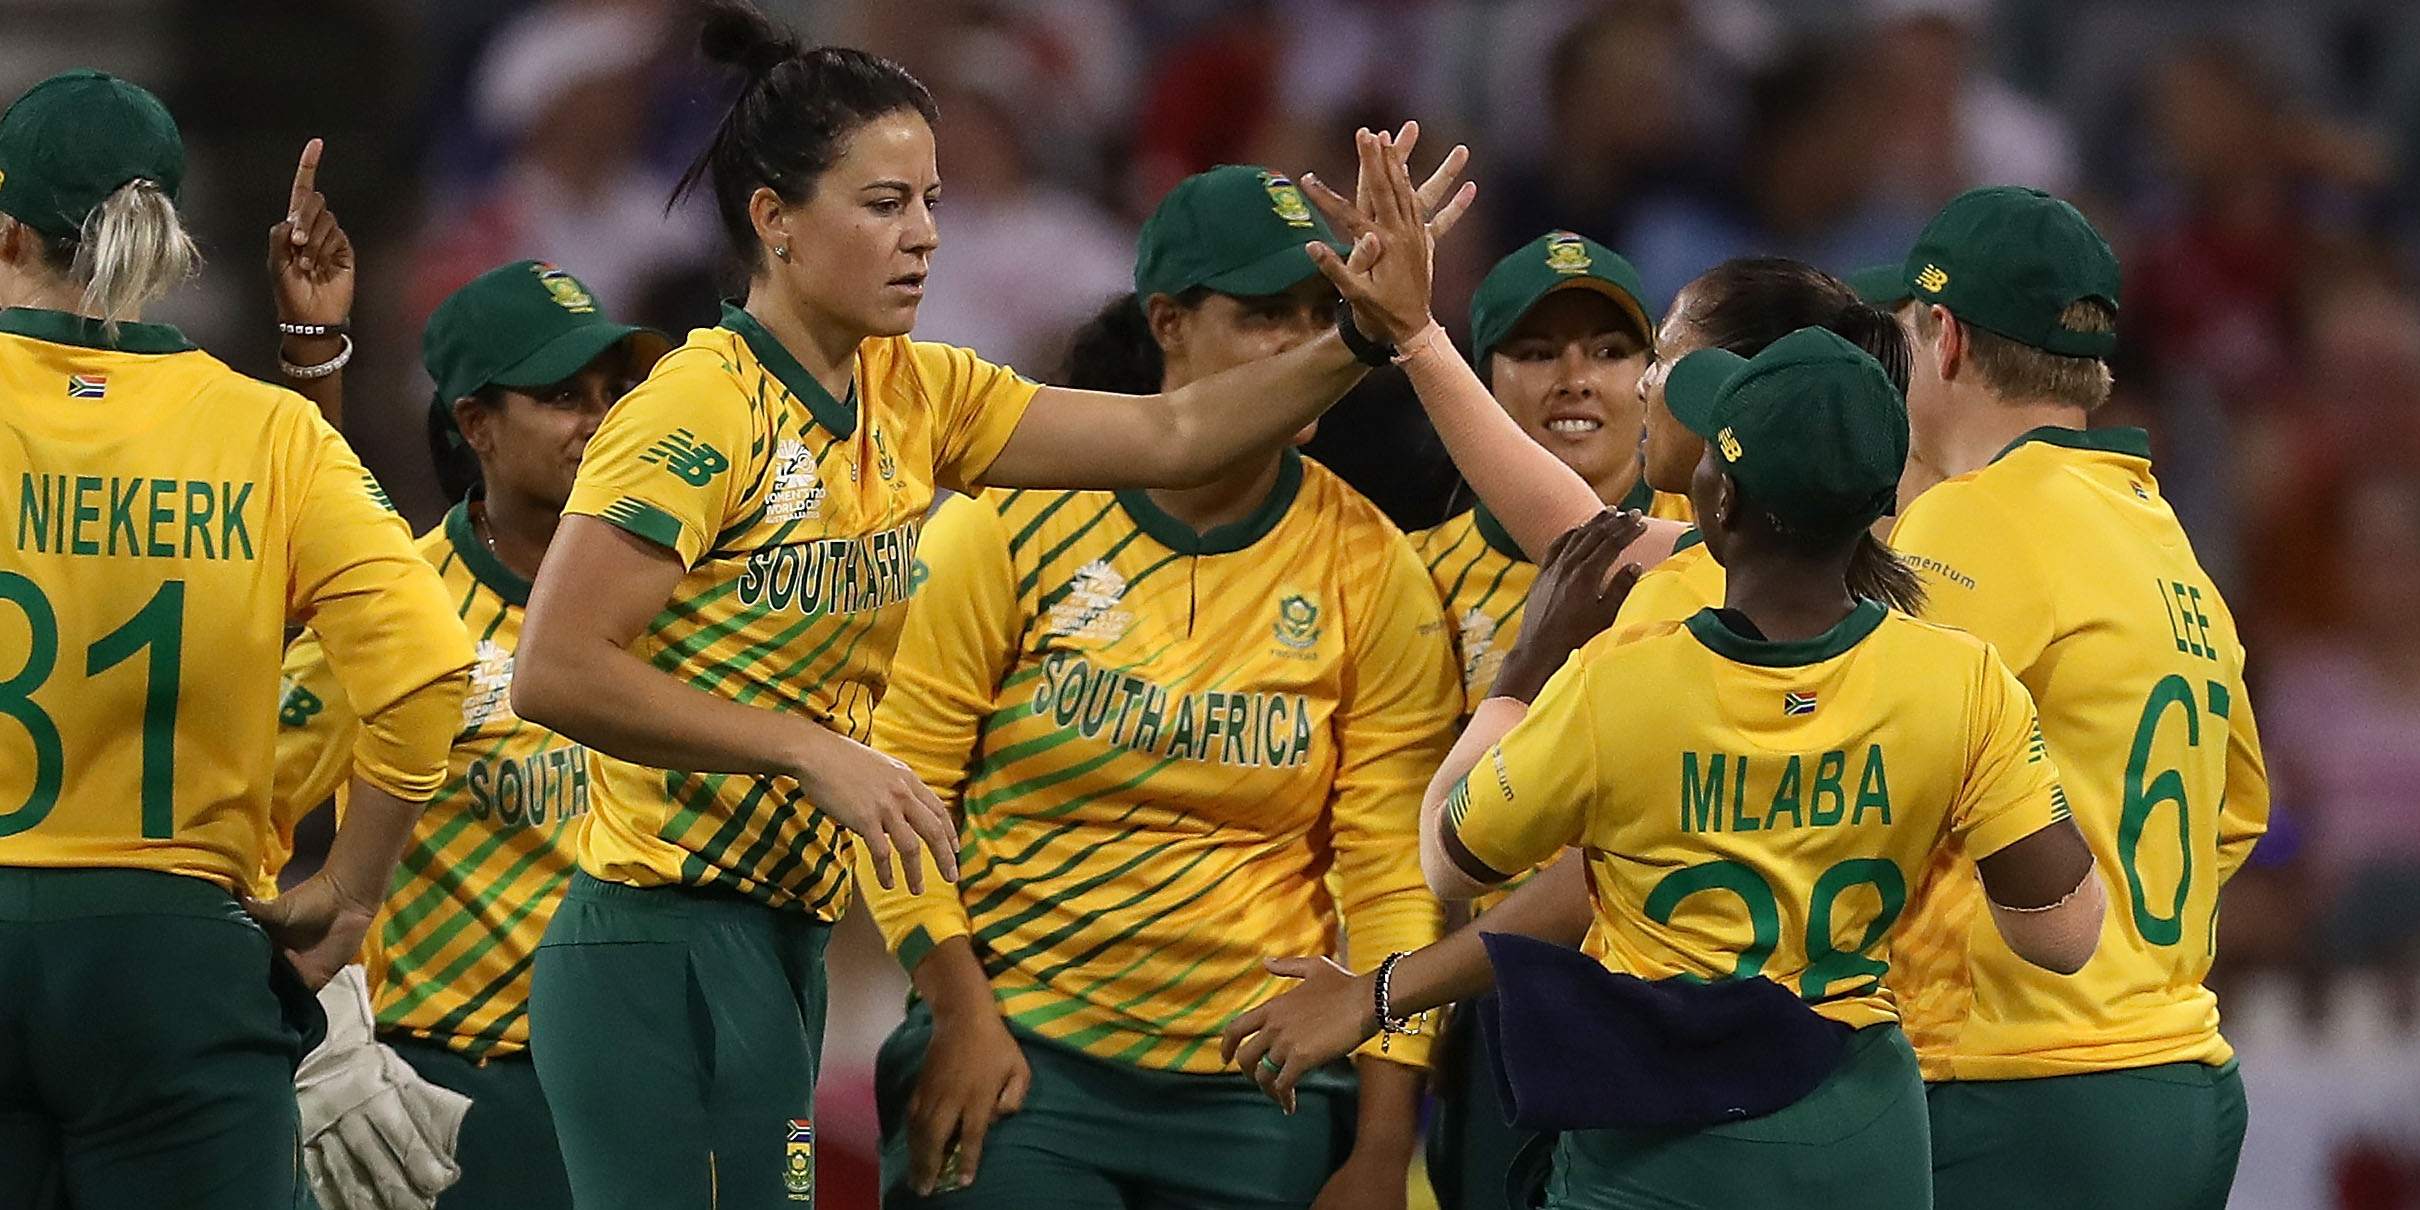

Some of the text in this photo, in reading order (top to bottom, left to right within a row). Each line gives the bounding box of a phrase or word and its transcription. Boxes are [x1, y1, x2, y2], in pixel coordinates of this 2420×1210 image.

[17, 472, 255, 560] NIEKERK
[738, 539, 858, 615] SOUTH
[859, 521, 918, 611] AFRIC
[2157, 578, 2217, 661] LEE
[1032, 650, 1314, 768] SOUTH AFRICA
[467, 742, 590, 828] SOUTH
[1681, 744, 1892, 833] MLABA
[1644, 858, 1907, 1004] 28
